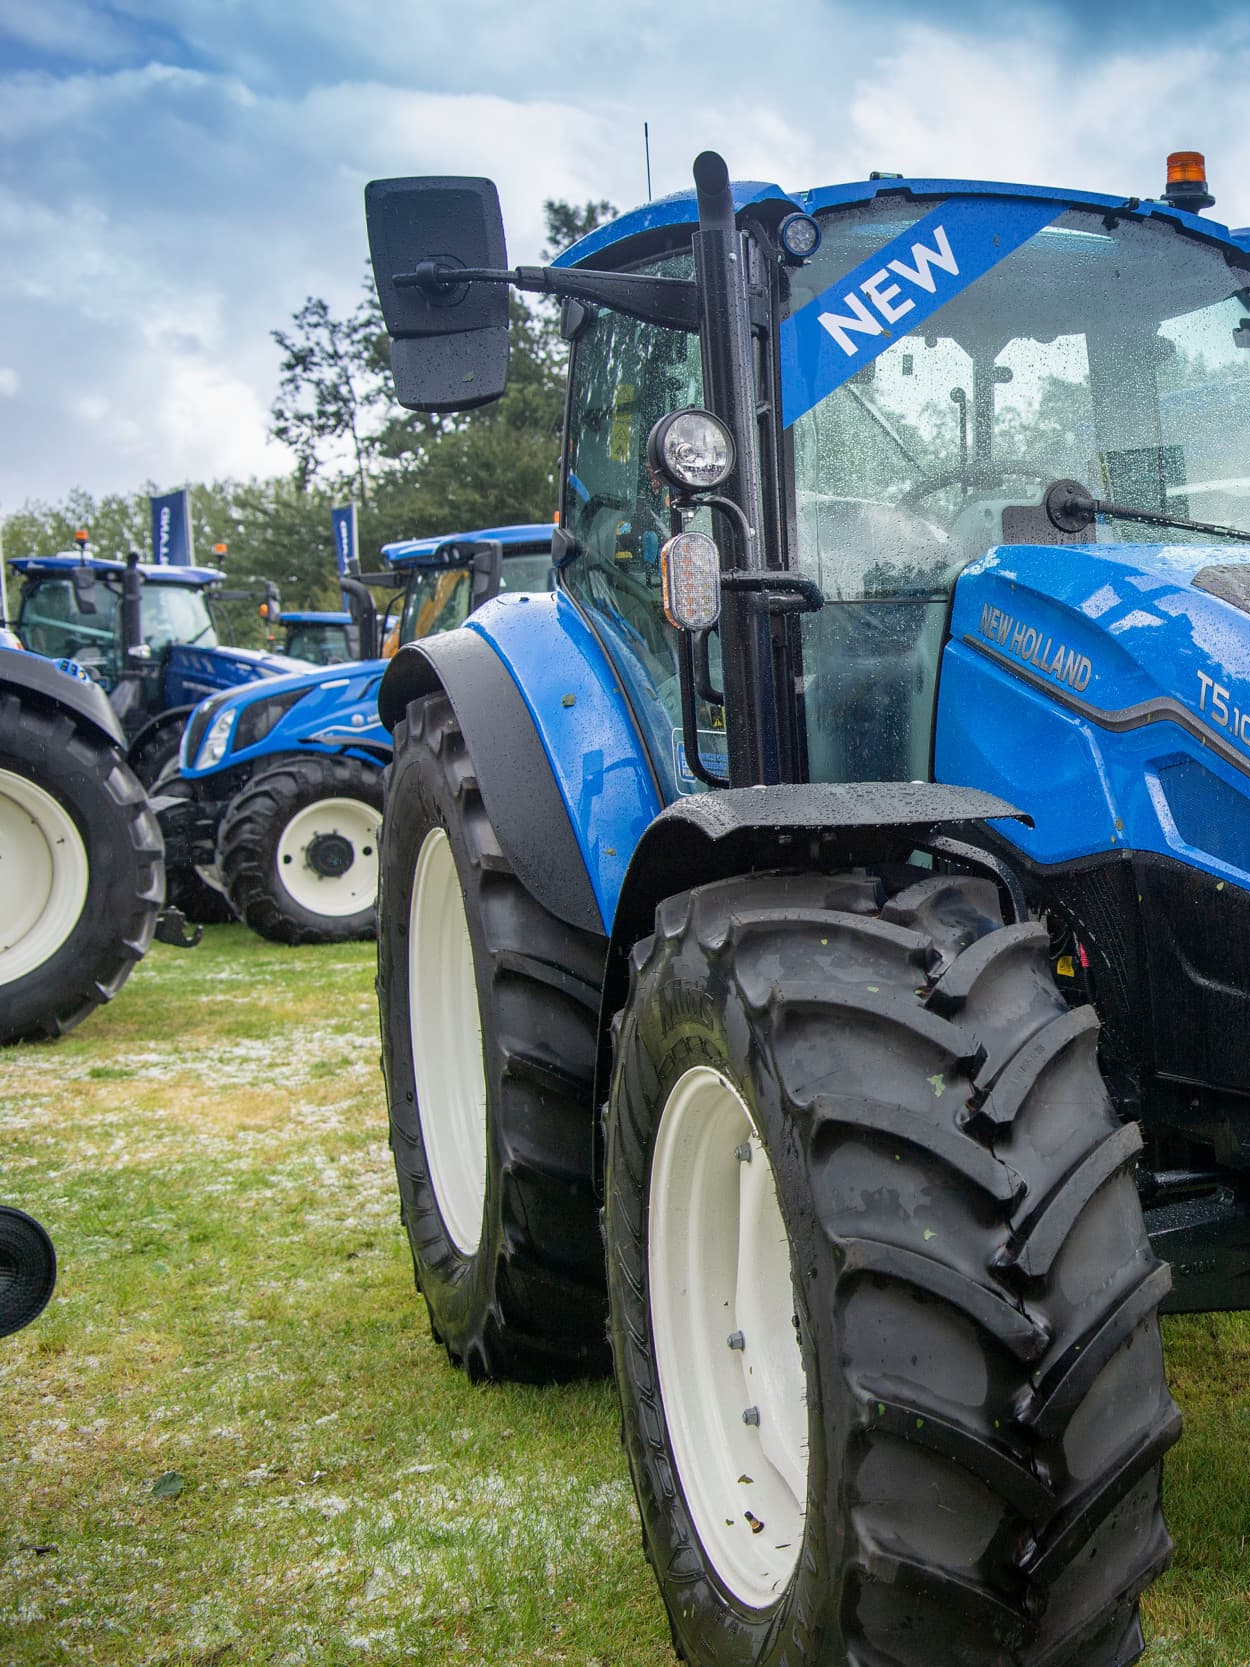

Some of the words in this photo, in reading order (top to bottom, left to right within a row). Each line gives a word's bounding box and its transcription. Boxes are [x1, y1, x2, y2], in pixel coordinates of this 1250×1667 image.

[817, 224, 960, 357] NEW
[978, 602, 1014, 648] NEW
[1008, 619, 1093, 692] HOLLAND
